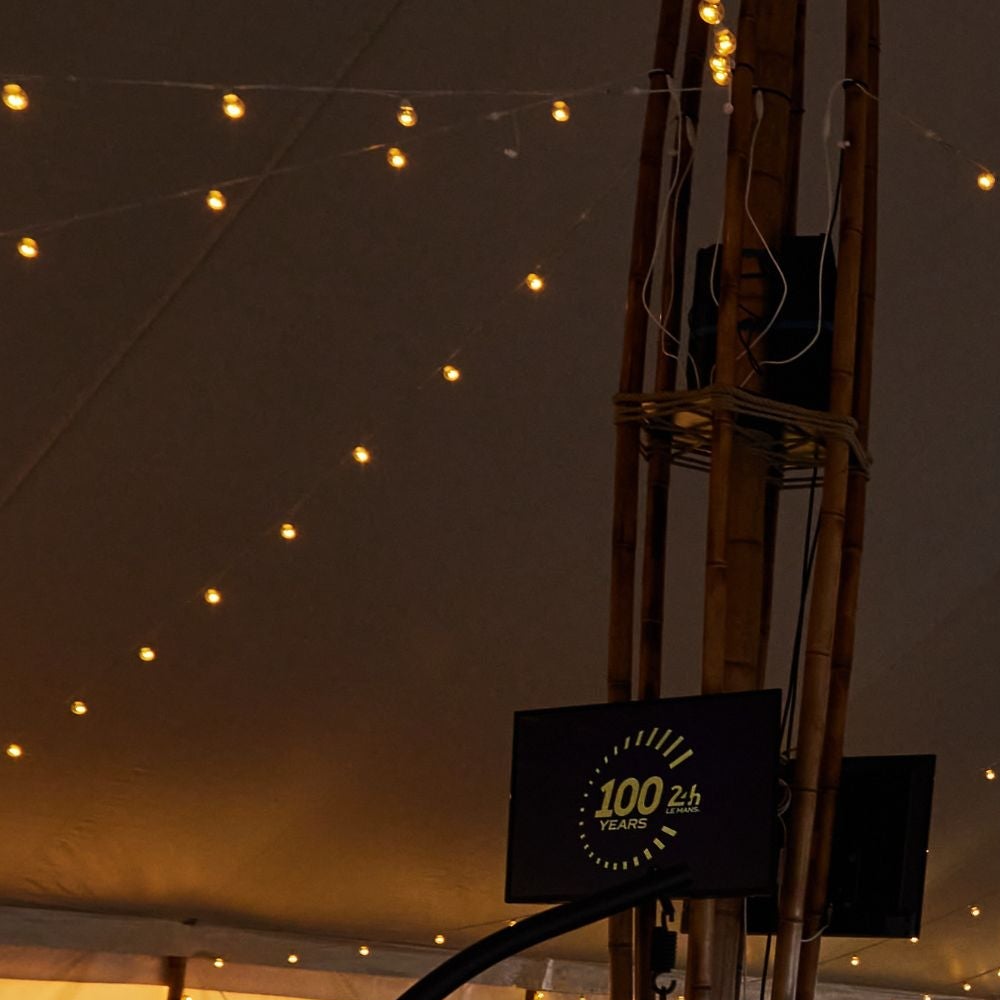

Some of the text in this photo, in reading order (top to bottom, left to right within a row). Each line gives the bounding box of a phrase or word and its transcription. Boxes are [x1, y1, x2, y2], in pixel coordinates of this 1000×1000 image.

[594, 775, 664, 818] 100
[665, 806, 699, 815] LE MANS
[599, 817, 648, 831] YEARS
